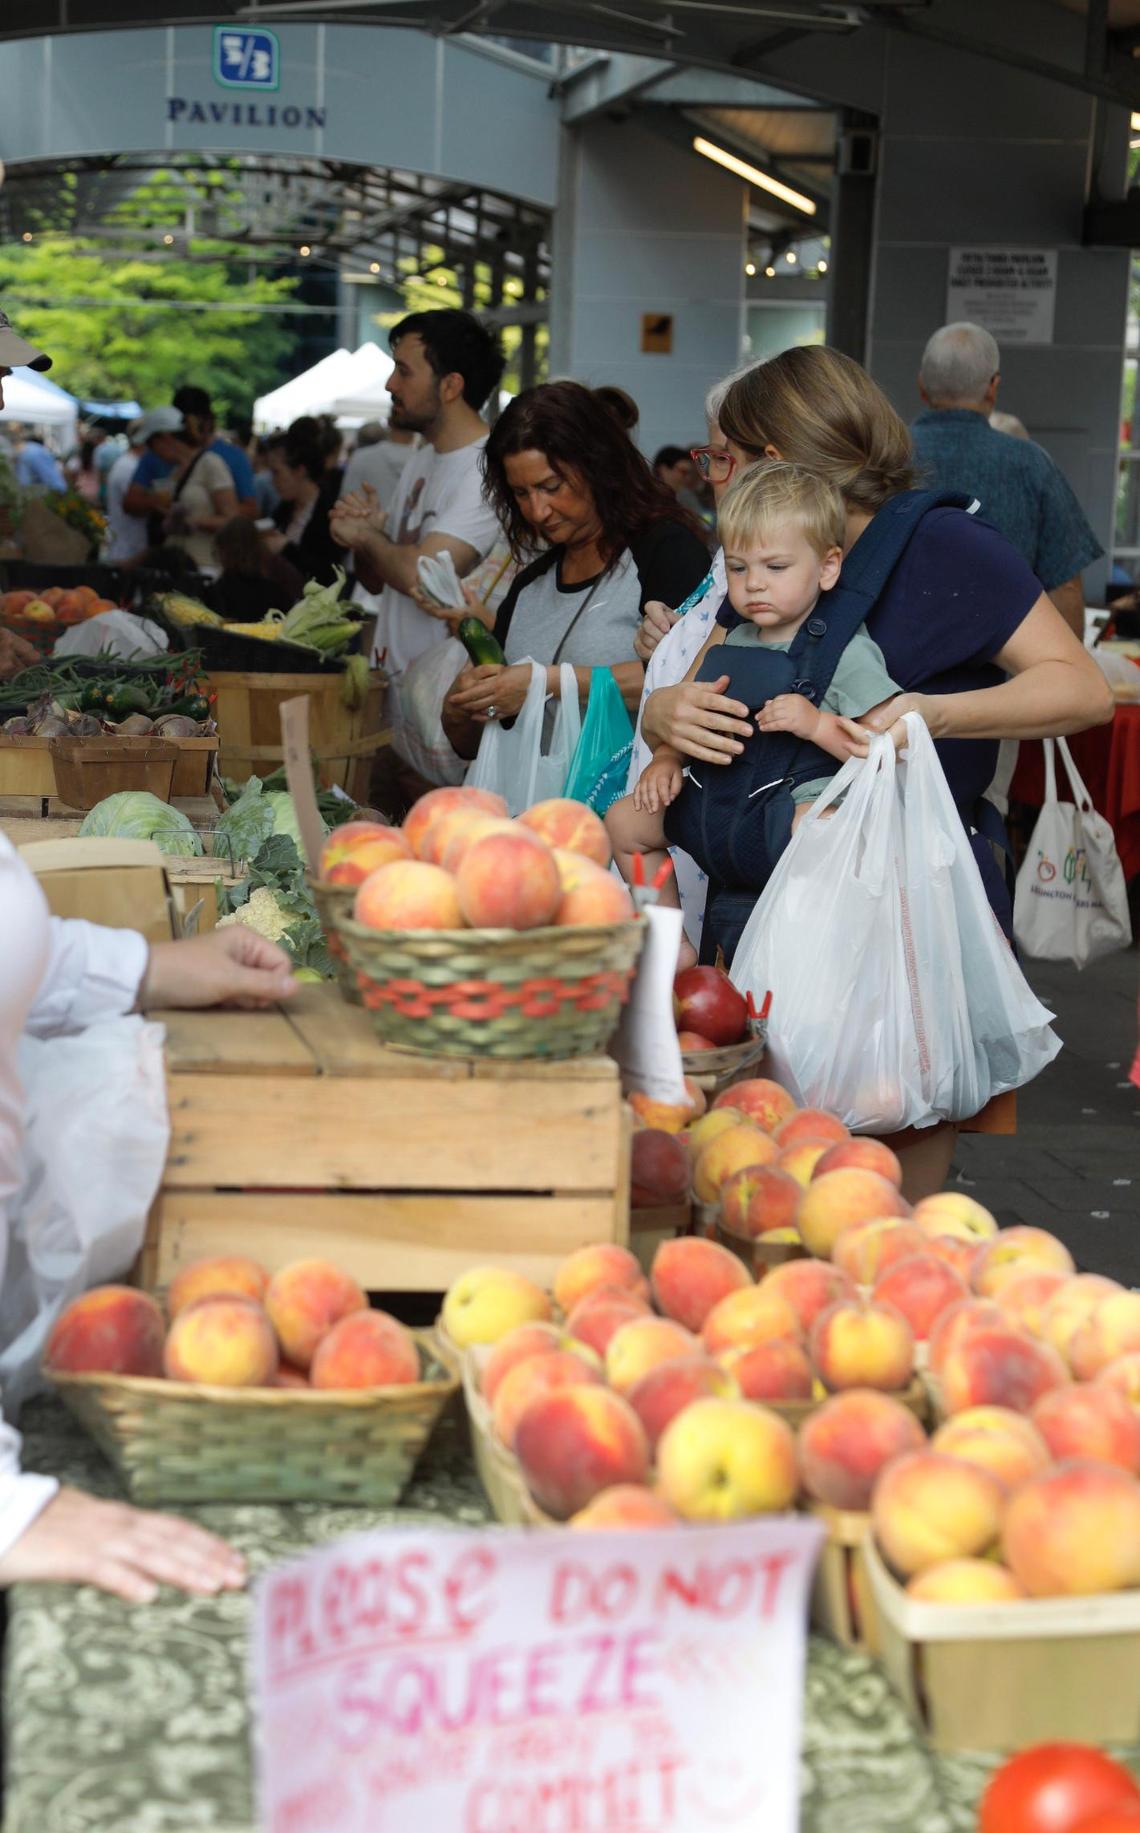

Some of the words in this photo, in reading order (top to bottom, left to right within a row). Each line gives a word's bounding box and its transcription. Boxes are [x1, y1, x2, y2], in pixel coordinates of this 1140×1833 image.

[167, 98, 327, 128] PAVILION
[549, 1559, 639, 1626] DO
[653, 1549, 798, 1621] NOT
[334, 1627, 664, 1754] SQUEEZE
